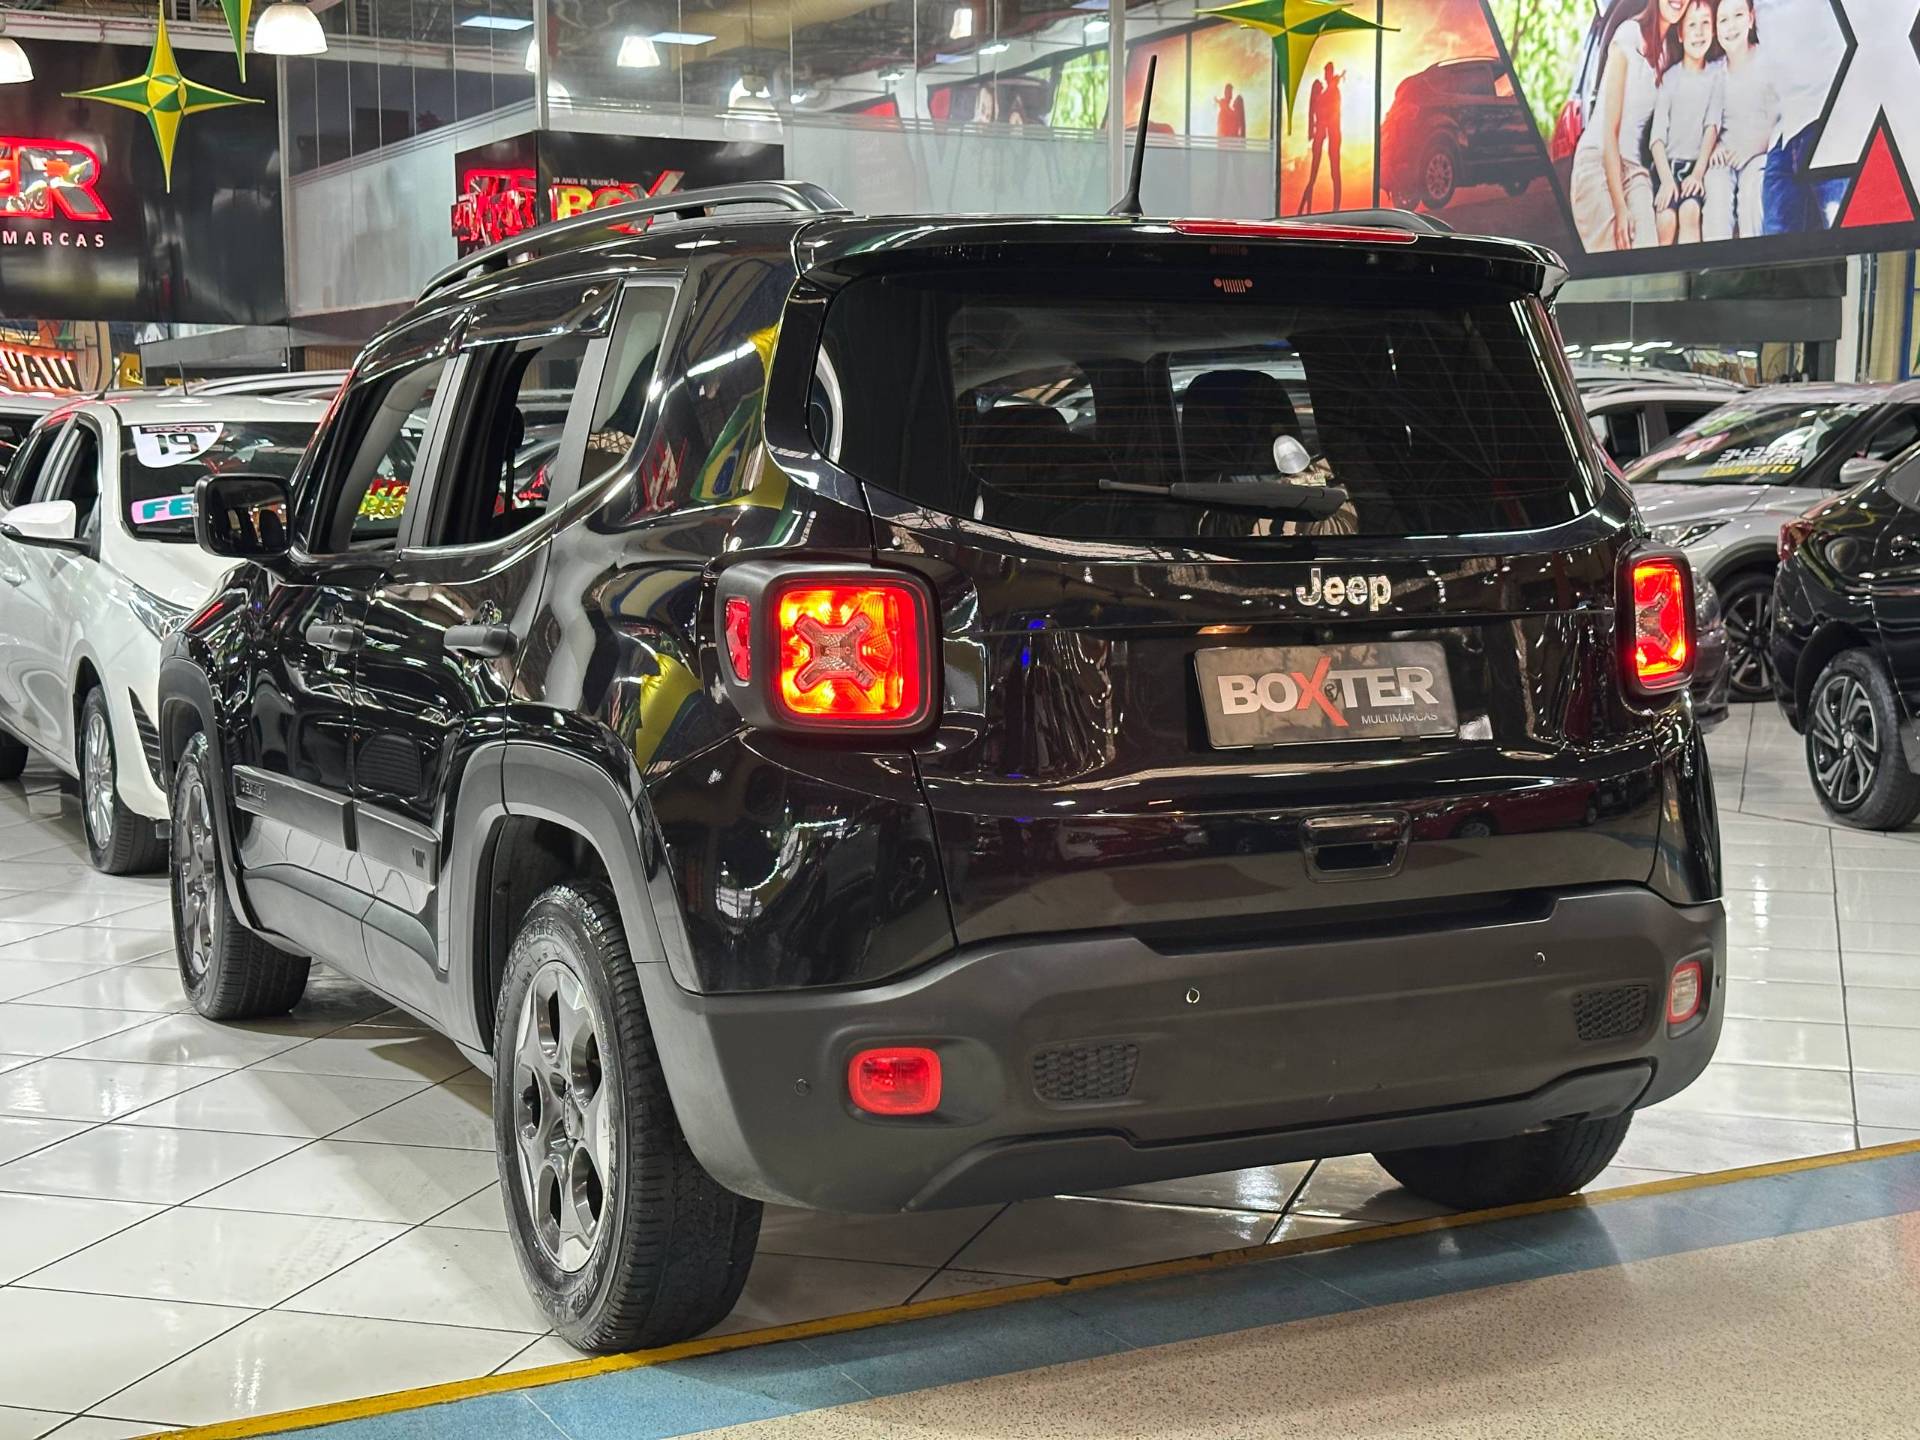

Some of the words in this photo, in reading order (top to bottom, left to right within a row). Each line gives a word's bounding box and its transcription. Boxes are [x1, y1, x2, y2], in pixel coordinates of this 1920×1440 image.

[2, 230, 105, 247] MARCAS
[155, 433, 200, 455] 19
[1296, 567, 1392, 612] Jeep
[1217, 656, 1440, 727] BOXTER
[1361, 712, 1439, 725] MULTIMARCAS
